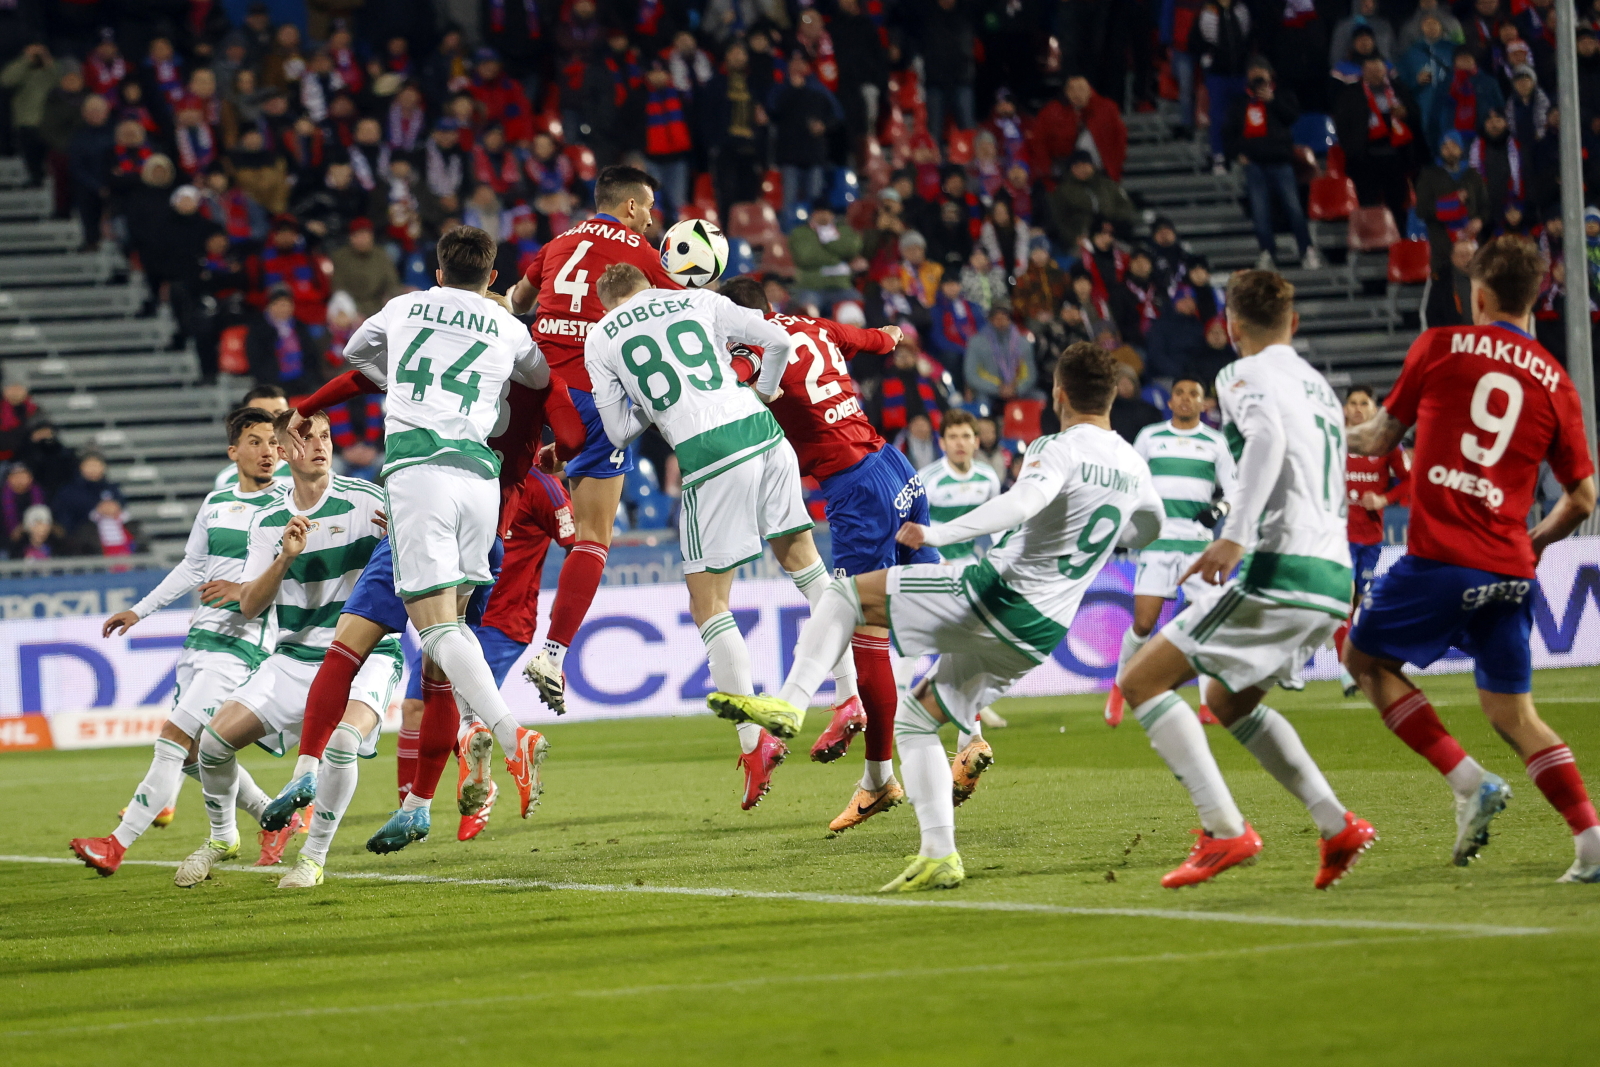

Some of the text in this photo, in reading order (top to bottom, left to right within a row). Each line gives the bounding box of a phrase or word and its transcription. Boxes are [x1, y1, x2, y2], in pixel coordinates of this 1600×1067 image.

[553, 240, 596, 313] 4
[407, 303, 499, 338] PLLANA
[602, 297, 695, 340] BOBČEK
[395, 328, 489, 416] 44
[620, 319, 724, 412] 89
[787, 327, 848, 405] 24
[1450, 332, 1560, 394] MAKUCH
[1460, 371, 1524, 467] 9
[609, 448, 625, 470] 4
[1058, 504, 1121, 580] 9
